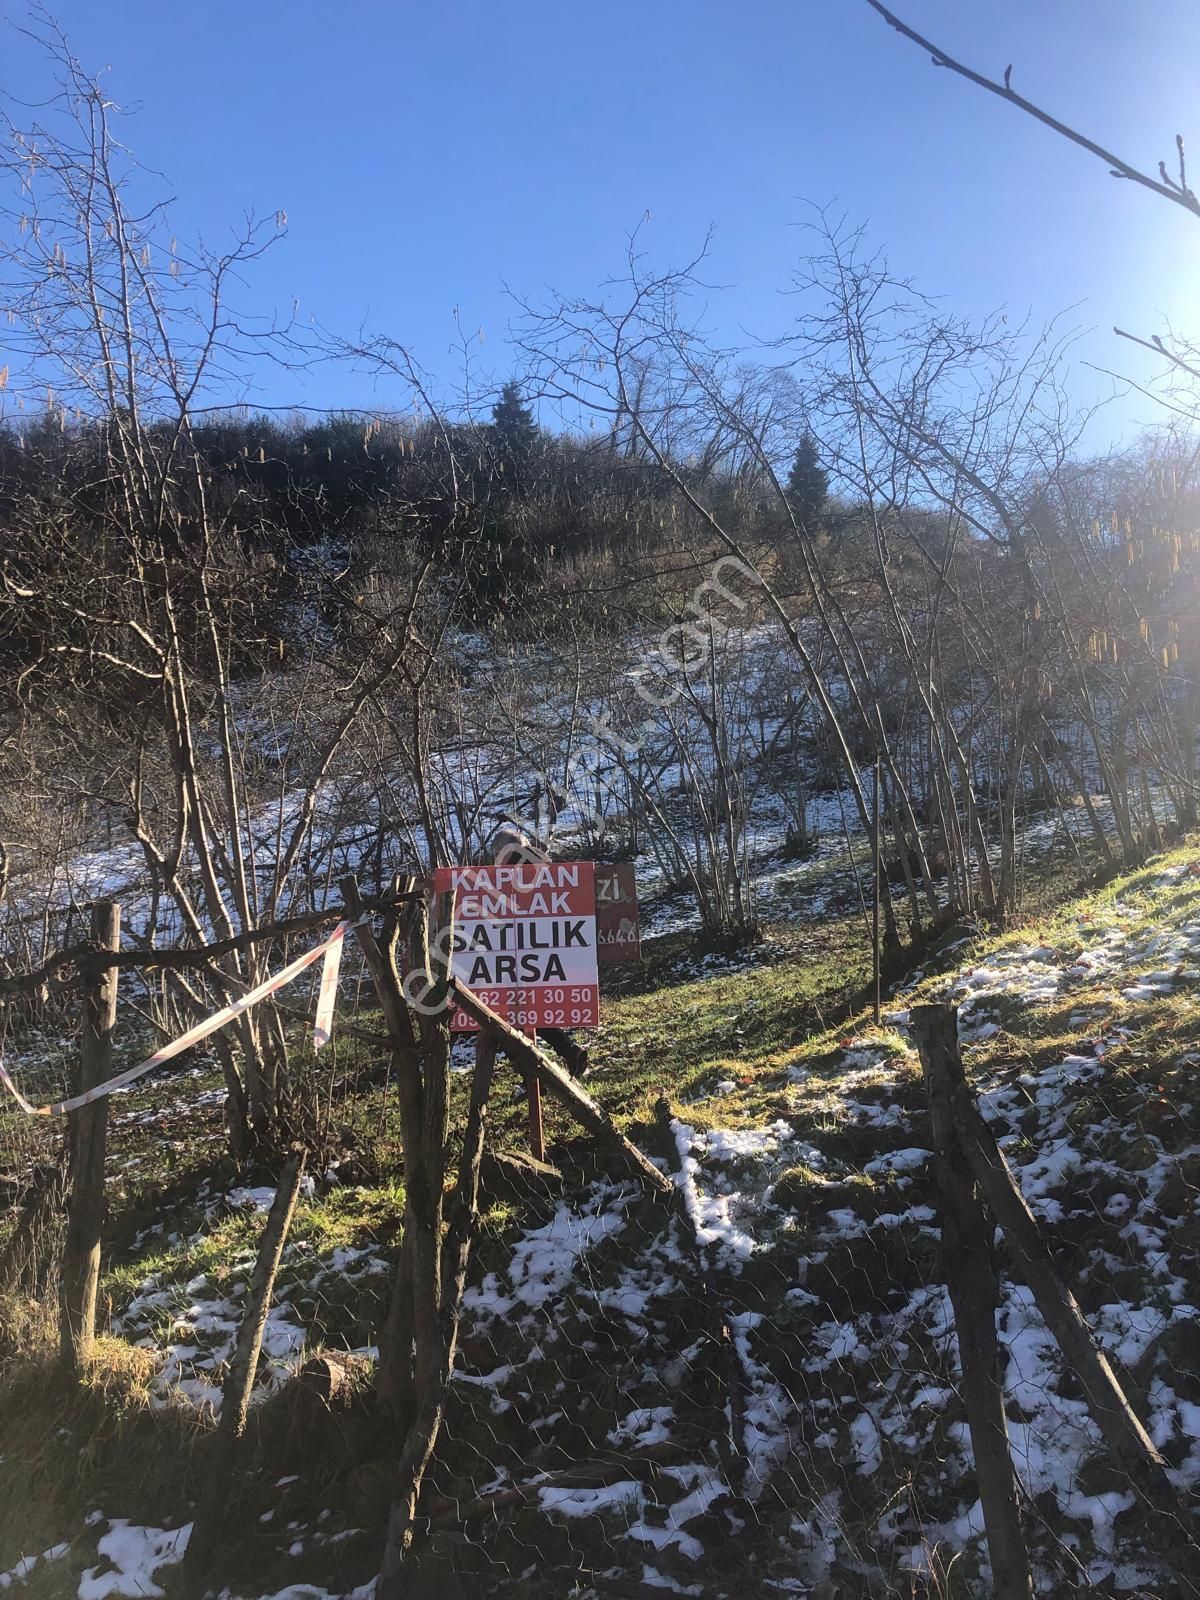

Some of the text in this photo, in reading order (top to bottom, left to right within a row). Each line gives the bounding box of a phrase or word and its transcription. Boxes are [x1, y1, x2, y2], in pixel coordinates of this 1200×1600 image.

[451, 865, 579, 891] KAPLAN
[461, 892, 572, 917] EMLAK
[452, 920, 591, 953] SATILIK
[468, 953, 567, 984] ARSA
[506, 990, 536, 1005] 221
[543, 989, 564, 1004] 30
[570, 988, 592, 1003] 50
[506, 1010, 538, 1025] 369
[543, 1009, 565, 1024] 92
[570, 1008, 592, 1023] 92
